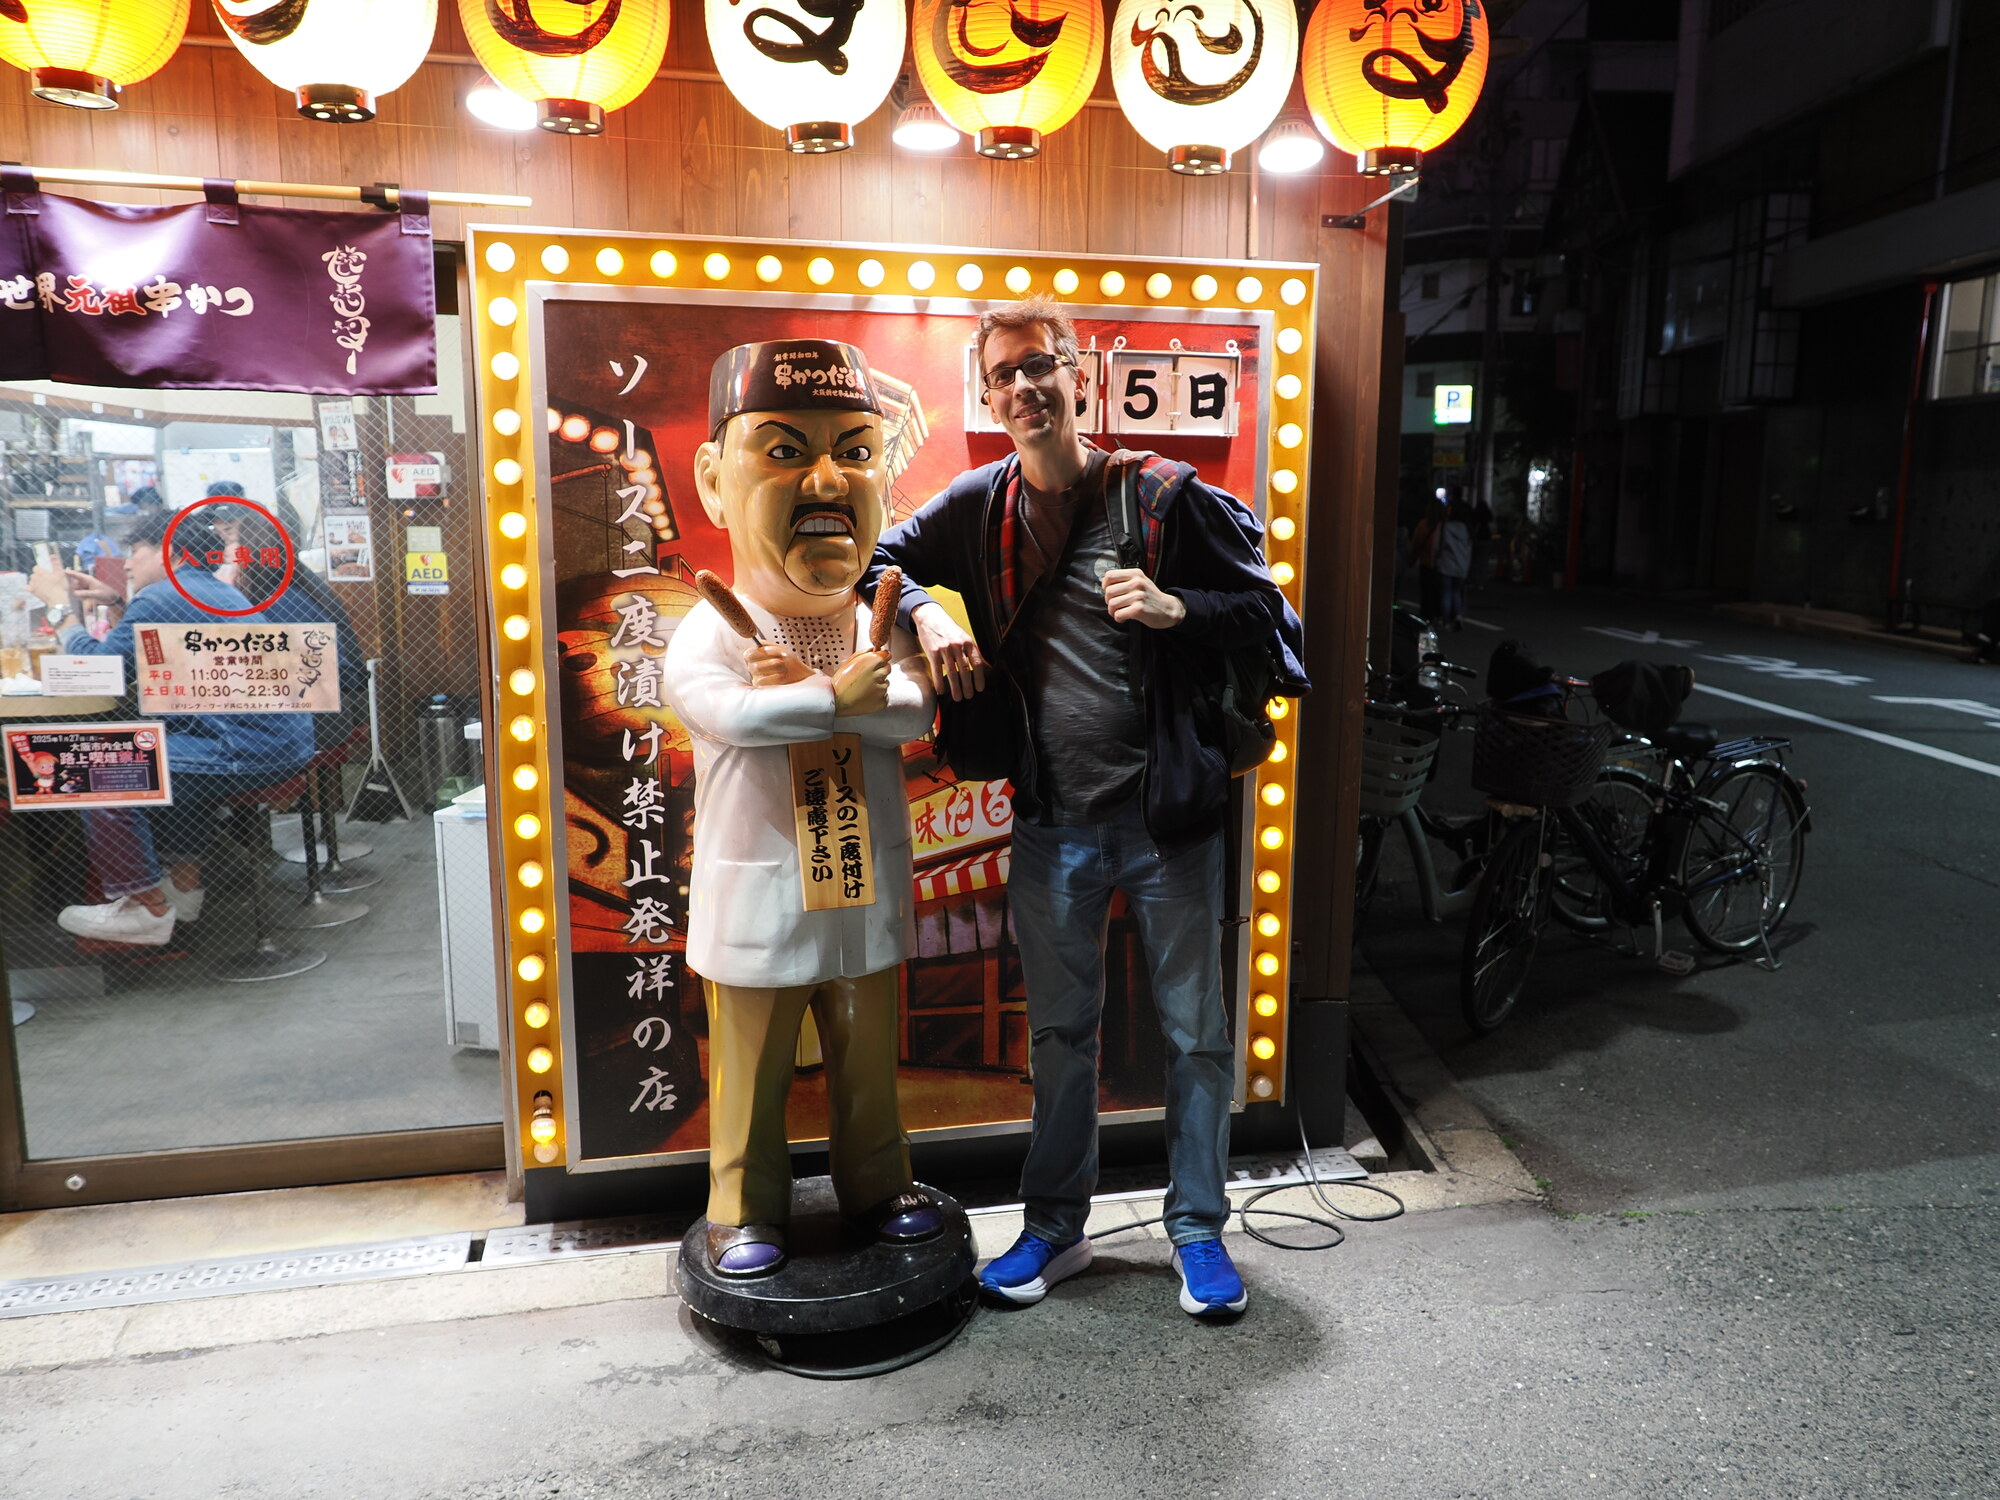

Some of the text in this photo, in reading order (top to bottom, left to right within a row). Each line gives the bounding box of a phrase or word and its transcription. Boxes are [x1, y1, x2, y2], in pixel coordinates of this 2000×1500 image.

[1447, 391, 1460, 408] P
[412, 467, 435, 476] AED
[411, 568, 443, 580] AED
[184, 629, 290, 655] 串かつだるま
[213, 655, 263, 666] 営業時間
[149, 670, 173, 681] 平日
[609, 354, 678, 1113] ソース二度漬け禁止発祥の店
[803, 767, 834, 883] ご遠慮下さい
[831, 747, 865, 900] ソースの二度付け
